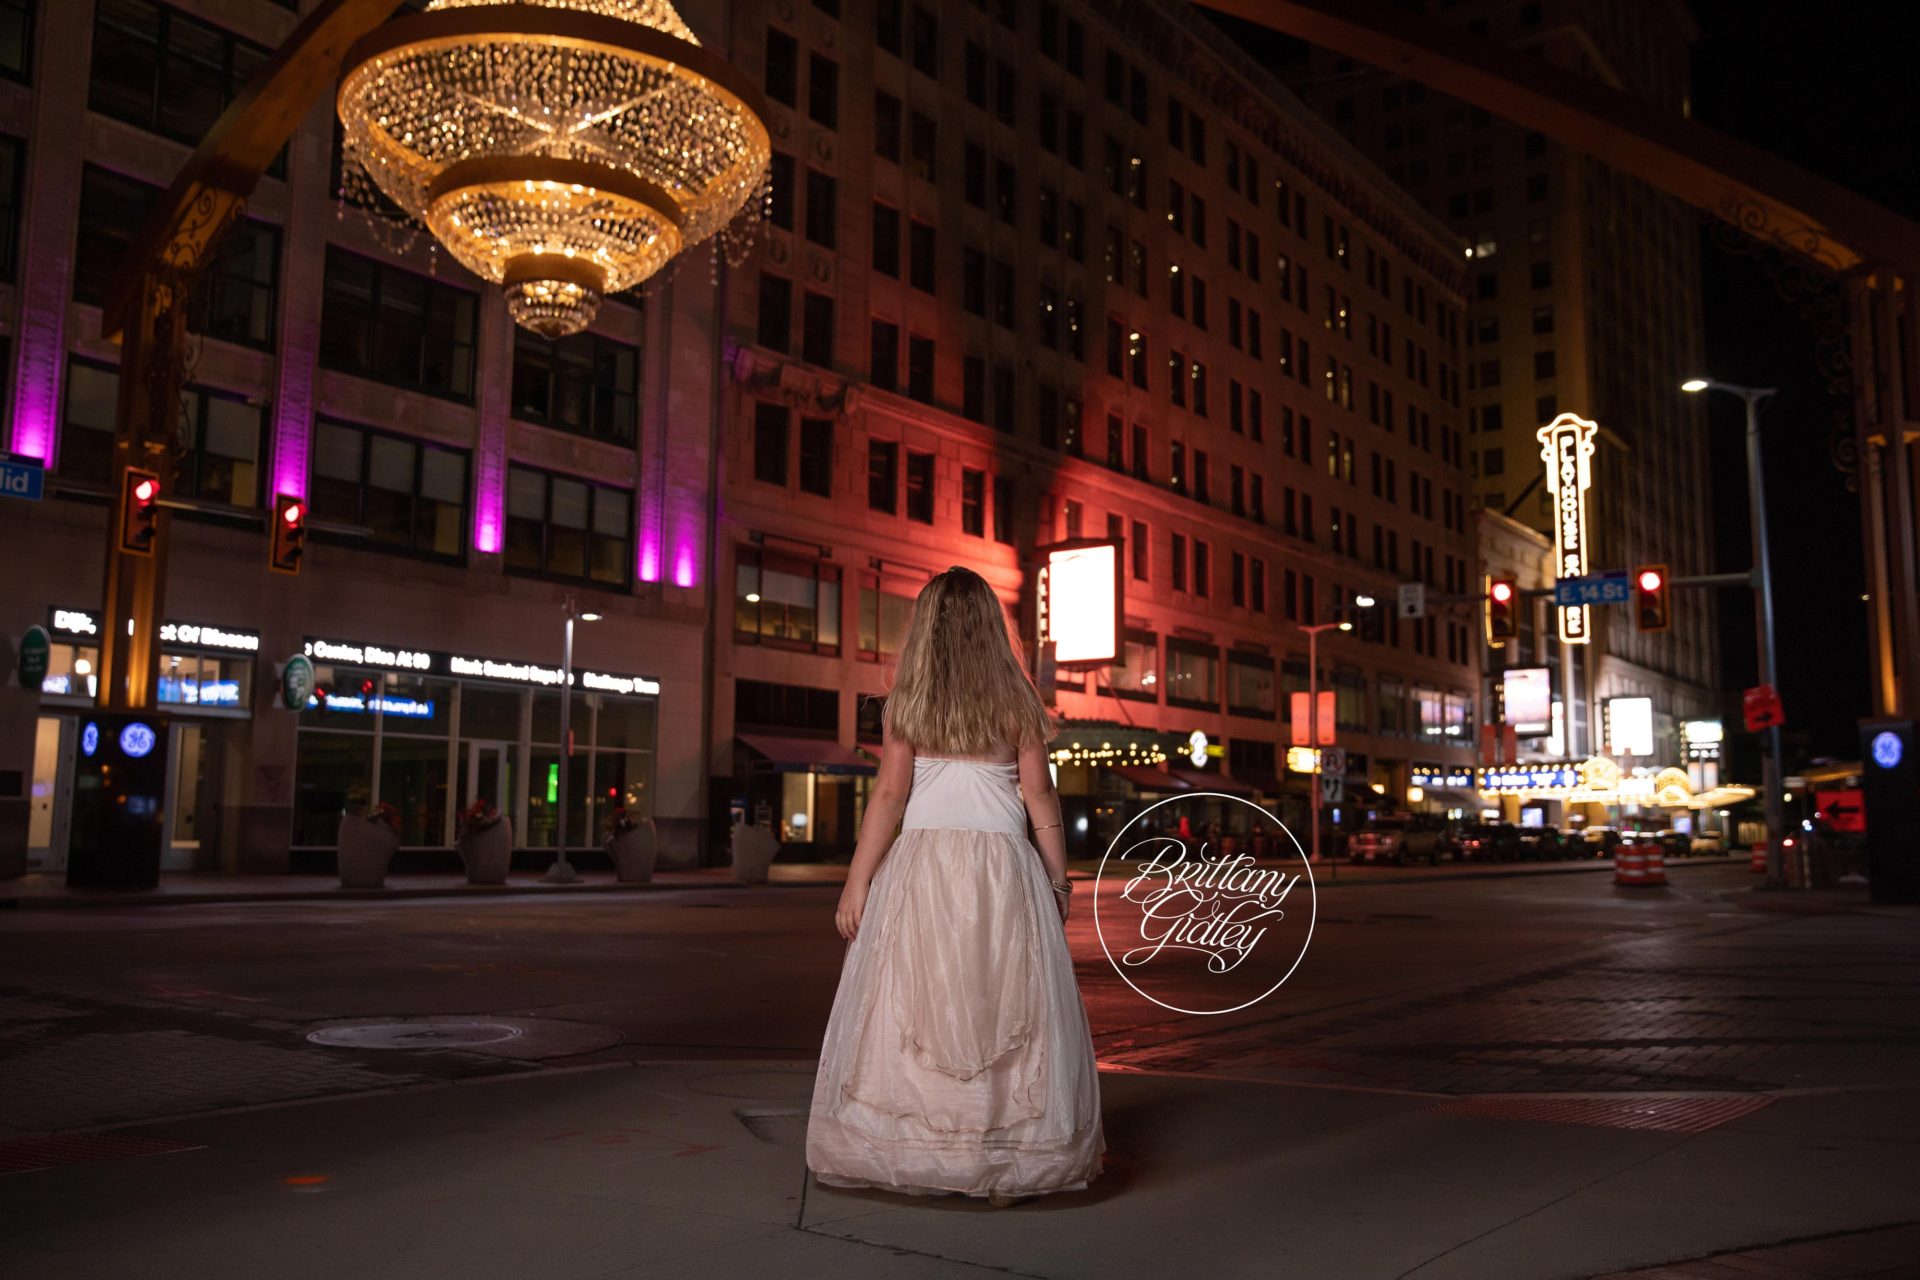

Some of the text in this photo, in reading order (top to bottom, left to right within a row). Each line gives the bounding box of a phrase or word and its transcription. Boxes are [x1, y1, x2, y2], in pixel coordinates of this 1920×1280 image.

[1560, 435, 1579, 550] PLAYHOUSE
[1578, 583, 1600, 601] 14
[1602, 582, 1625, 600] St
